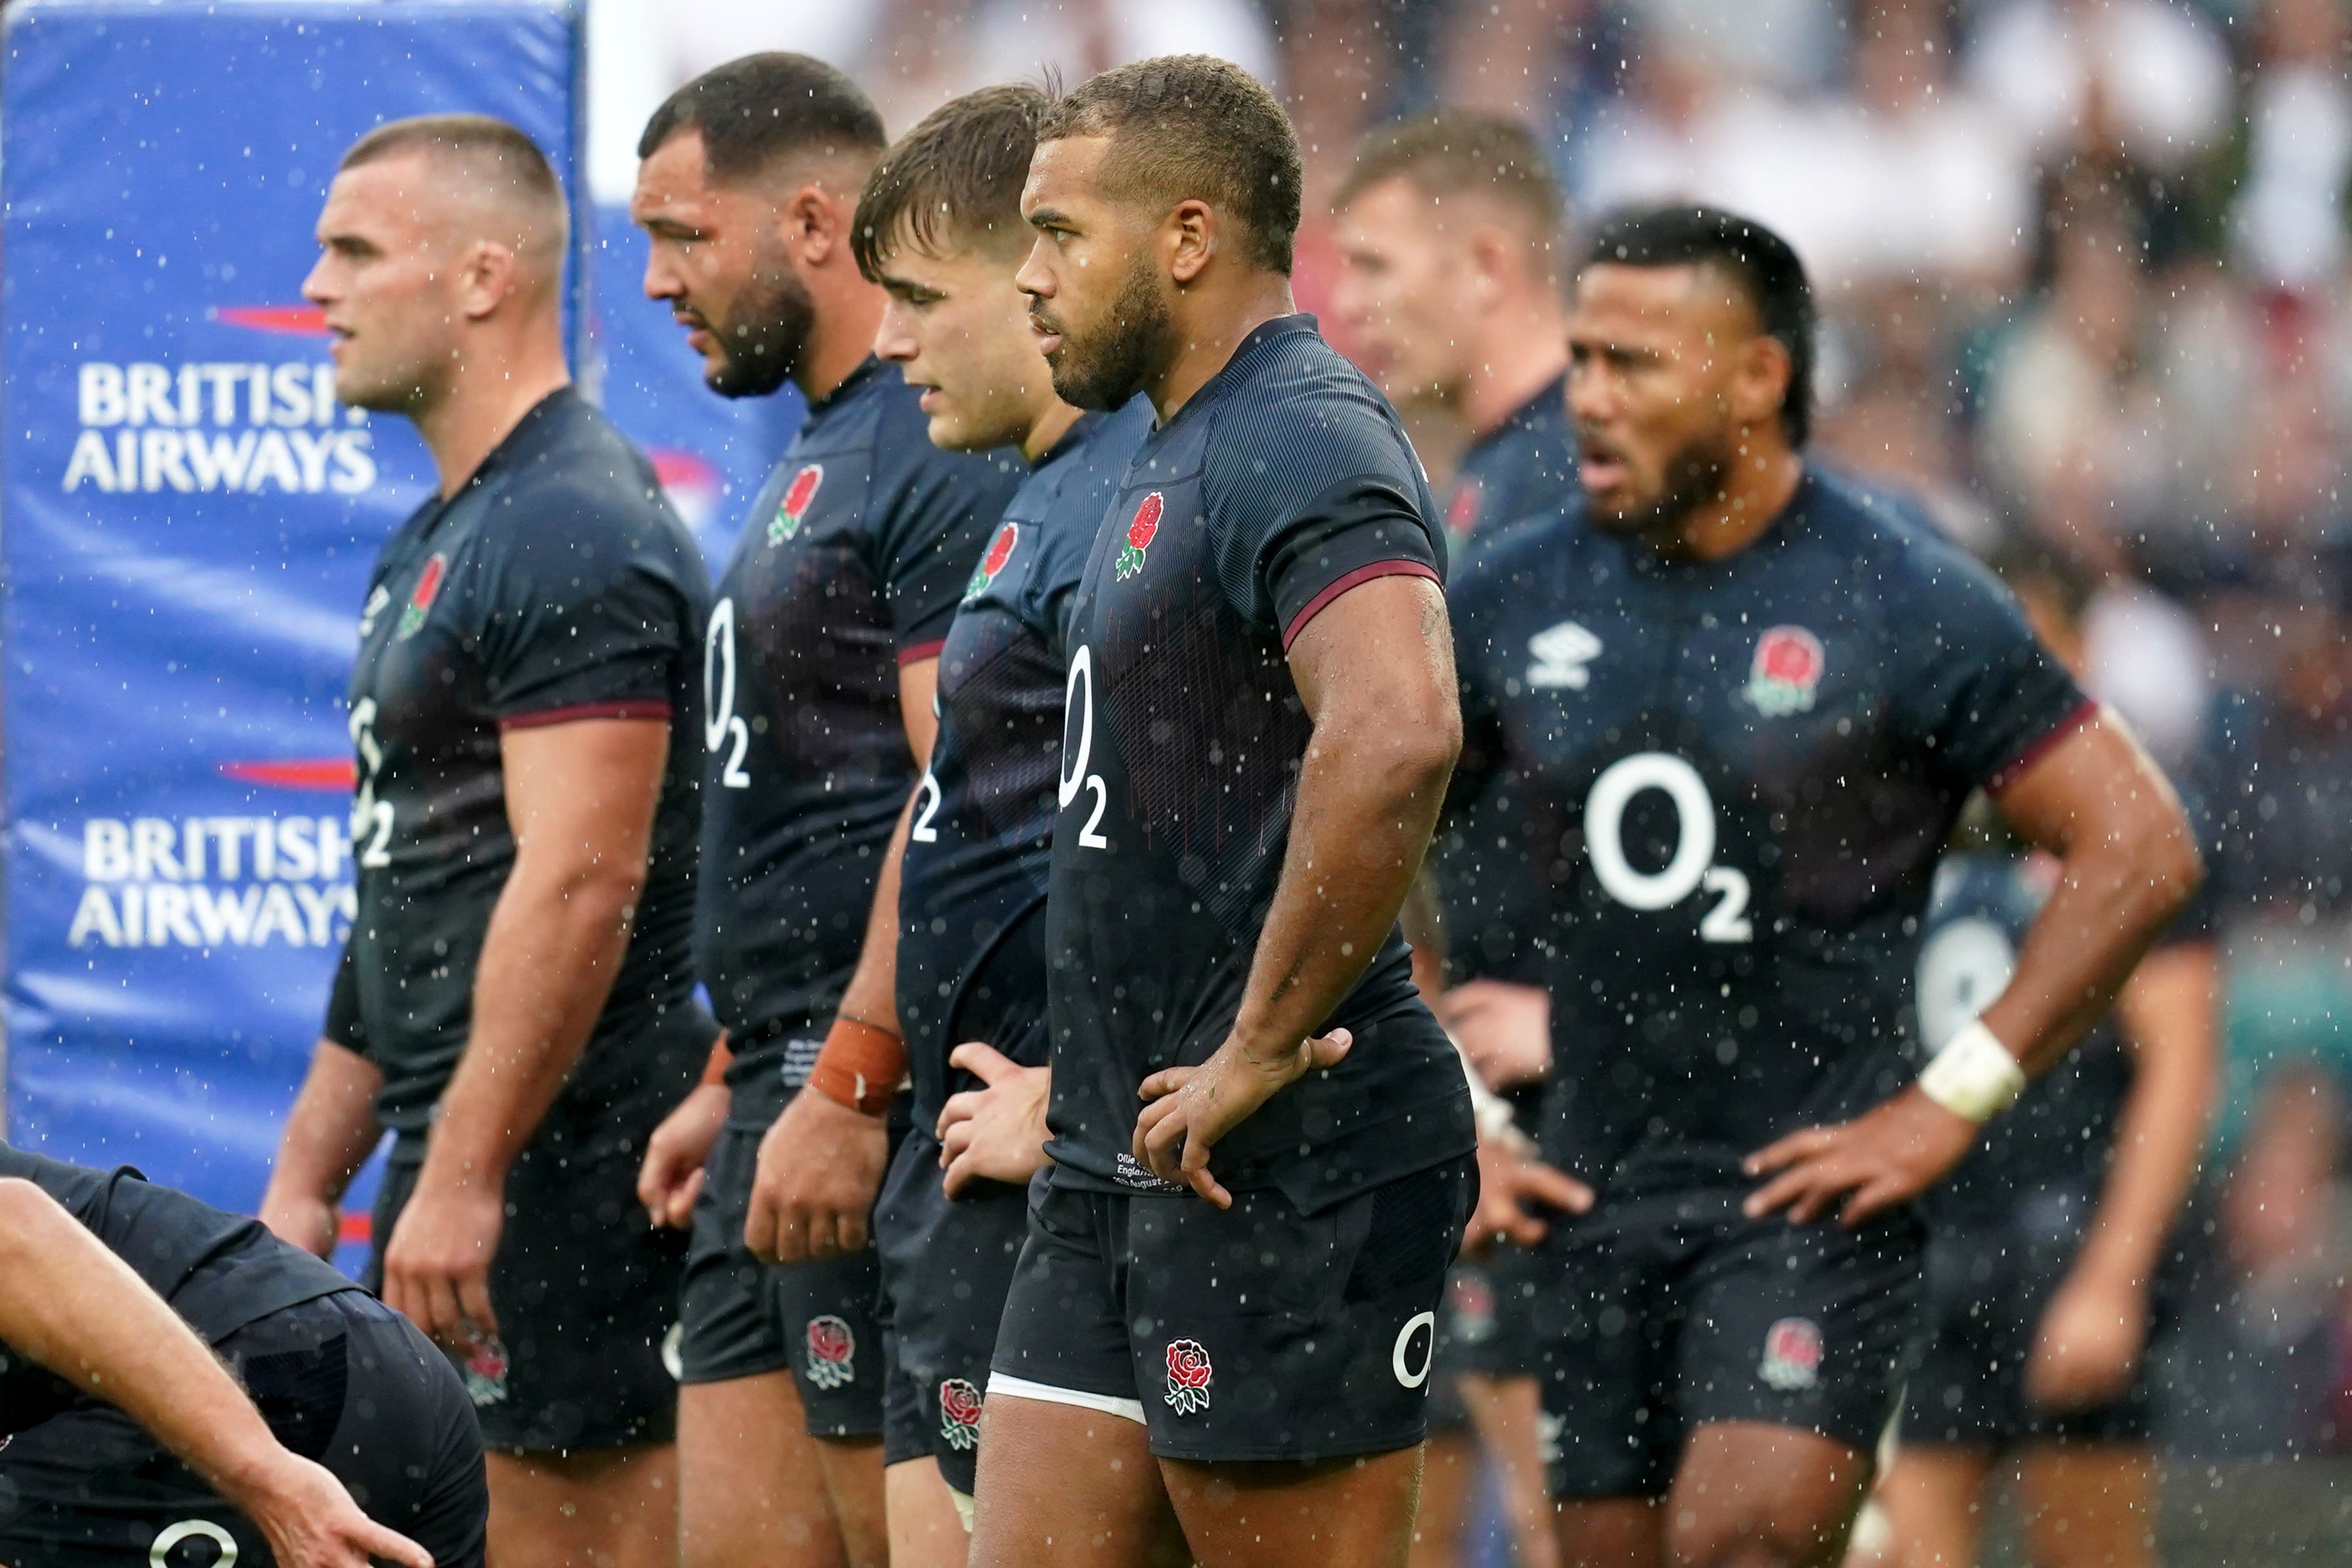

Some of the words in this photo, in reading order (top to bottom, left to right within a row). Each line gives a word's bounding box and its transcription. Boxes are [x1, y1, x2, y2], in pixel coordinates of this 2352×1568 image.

[62, 428, 377, 493] AIRWAYS
[704, 597, 750, 788] O2
[1058, 644, 1108, 849] O2
[1584, 751, 1753, 943] O2
[1117, 1153, 1135, 1165] Ollie
[1129, 1177, 1162, 1190] August
